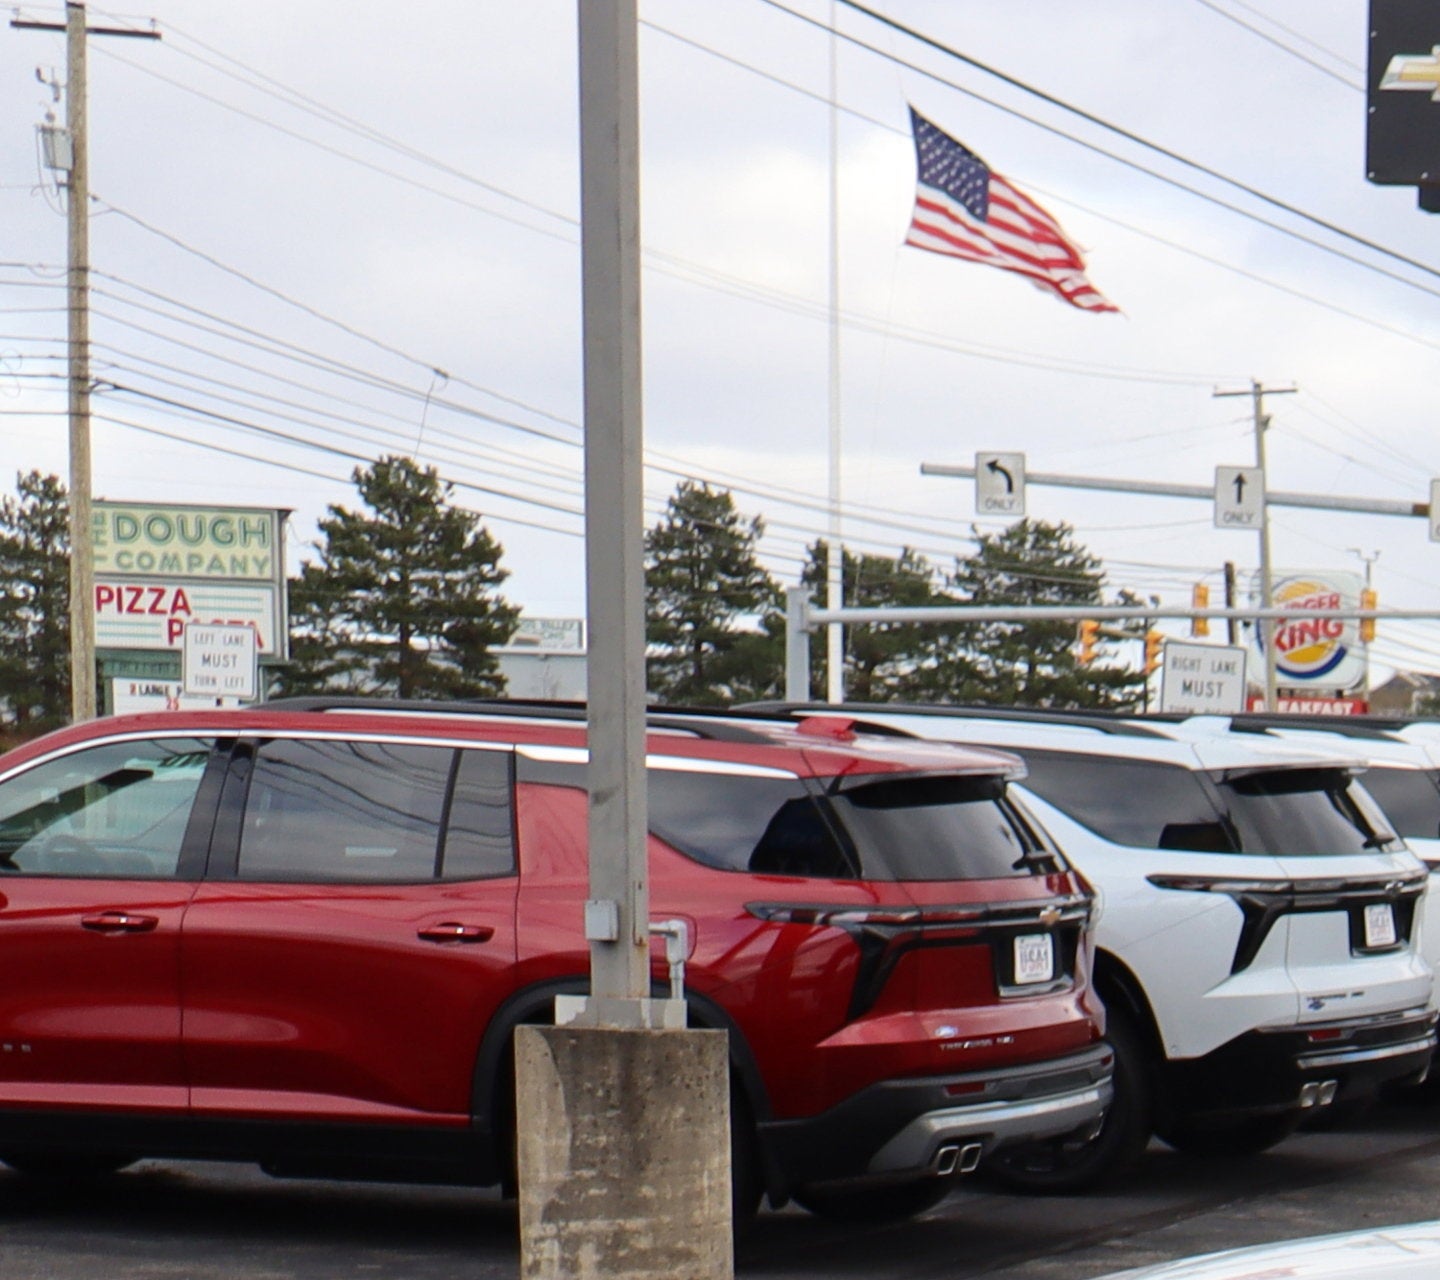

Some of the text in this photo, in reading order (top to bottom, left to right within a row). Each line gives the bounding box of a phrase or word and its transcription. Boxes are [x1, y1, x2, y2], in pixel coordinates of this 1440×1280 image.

[985, 498, 1015, 511] ONLY
[1223, 511, 1255, 524] ONLY
[112, 512, 270, 548] DOUGH
[115, 550, 269, 576] COMPANY
[95, 585, 192, 616] PIZZA
[194, 632, 215, 645] LEFT
[222, 634, 244, 647] LANE
[201, 653, 237, 668] MUST
[1172, 656, 1236, 675] RIGHT LANE
[194, 674, 244, 688] TURN LEFT
[1182, 679, 1223, 698] MUST
[1253, 699, 1354, 715] BEAKFAST
